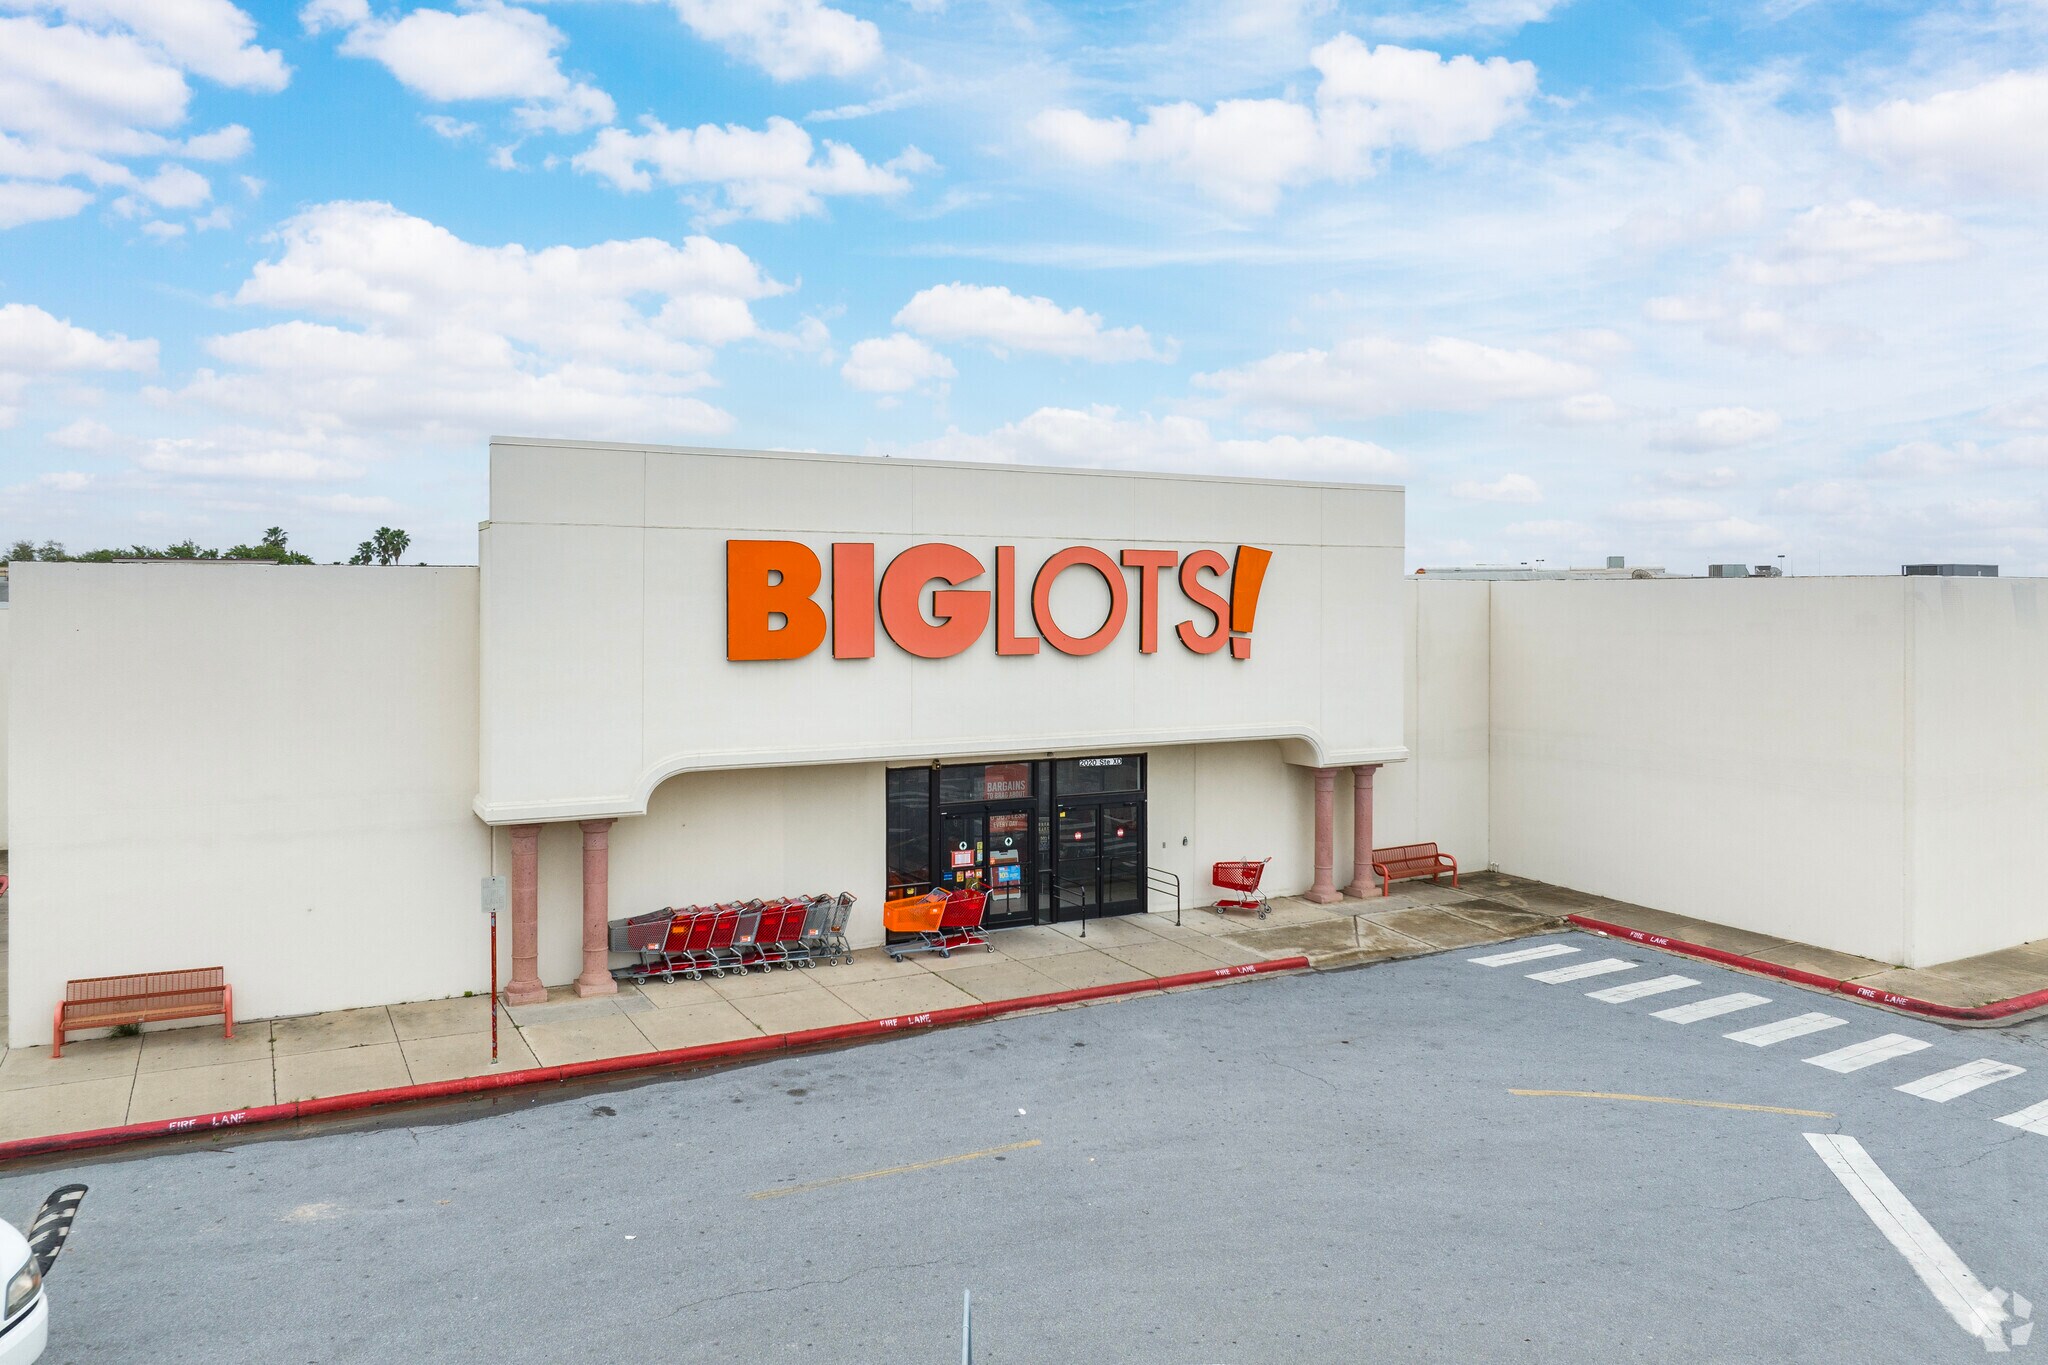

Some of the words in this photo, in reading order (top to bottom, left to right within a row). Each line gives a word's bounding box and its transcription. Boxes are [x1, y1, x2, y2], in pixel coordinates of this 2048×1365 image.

[726, 540, 991, 661] BIG
[994, 545, 1273, 660] LOTS!
[1079, 758, 1096, 767] 2020
[987, 780, 1026, 792] BARGAINS
[987, 792, 994, 800] TO
[995, 792, 1009, 800] BRAG
[1009, 790, 1025, 798] ABOUT
[1630, 931, 1645, 940] FIRE
[1650, 936, 1669, 945] LANE
[1215, 968, 1230, 976] FIRE
[1237, 965, 1256, 974] LANE
[1857, 988, 1876, 998] FIRE
[1884, 994, 1908, 1005] LANE
[880, 1018, 898, 1027] FIRE
[908, 1014, 931, 1025] LANE
